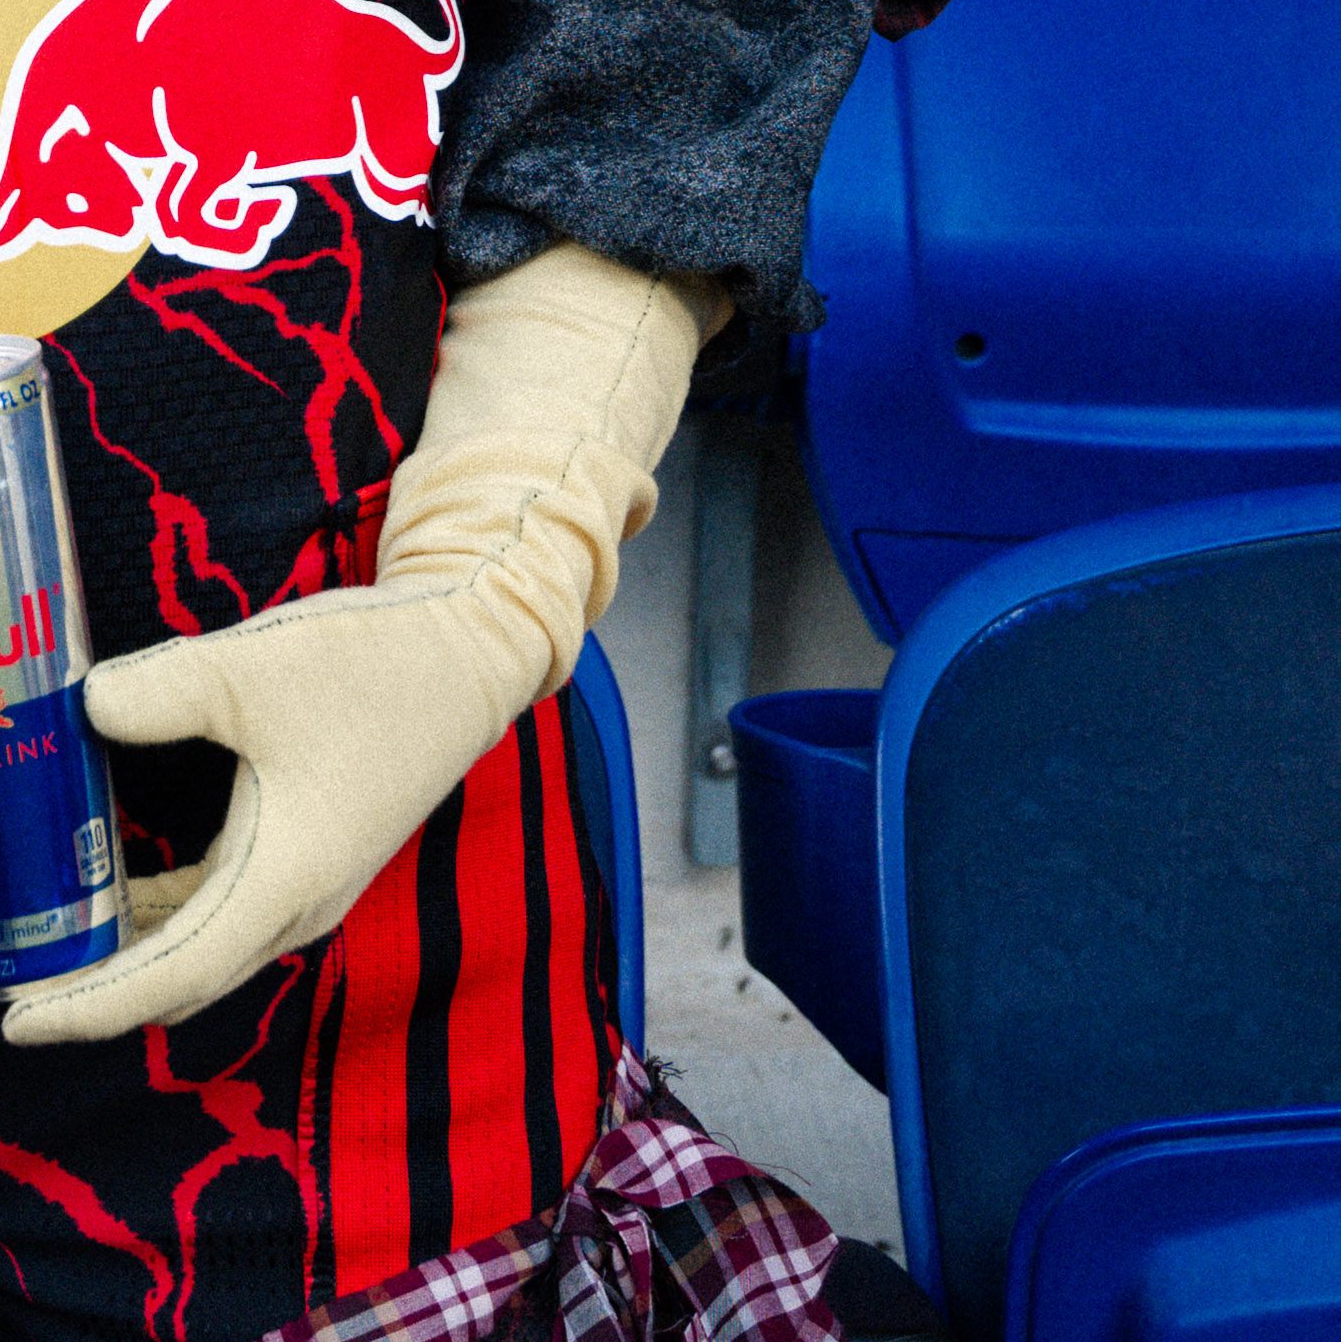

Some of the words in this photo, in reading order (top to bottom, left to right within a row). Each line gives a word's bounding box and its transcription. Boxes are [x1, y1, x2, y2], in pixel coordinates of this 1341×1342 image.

[0, 389, 18, 411] FL
[20, 379, 41, 403] OZ
[80, 824, 104, 854] 110
